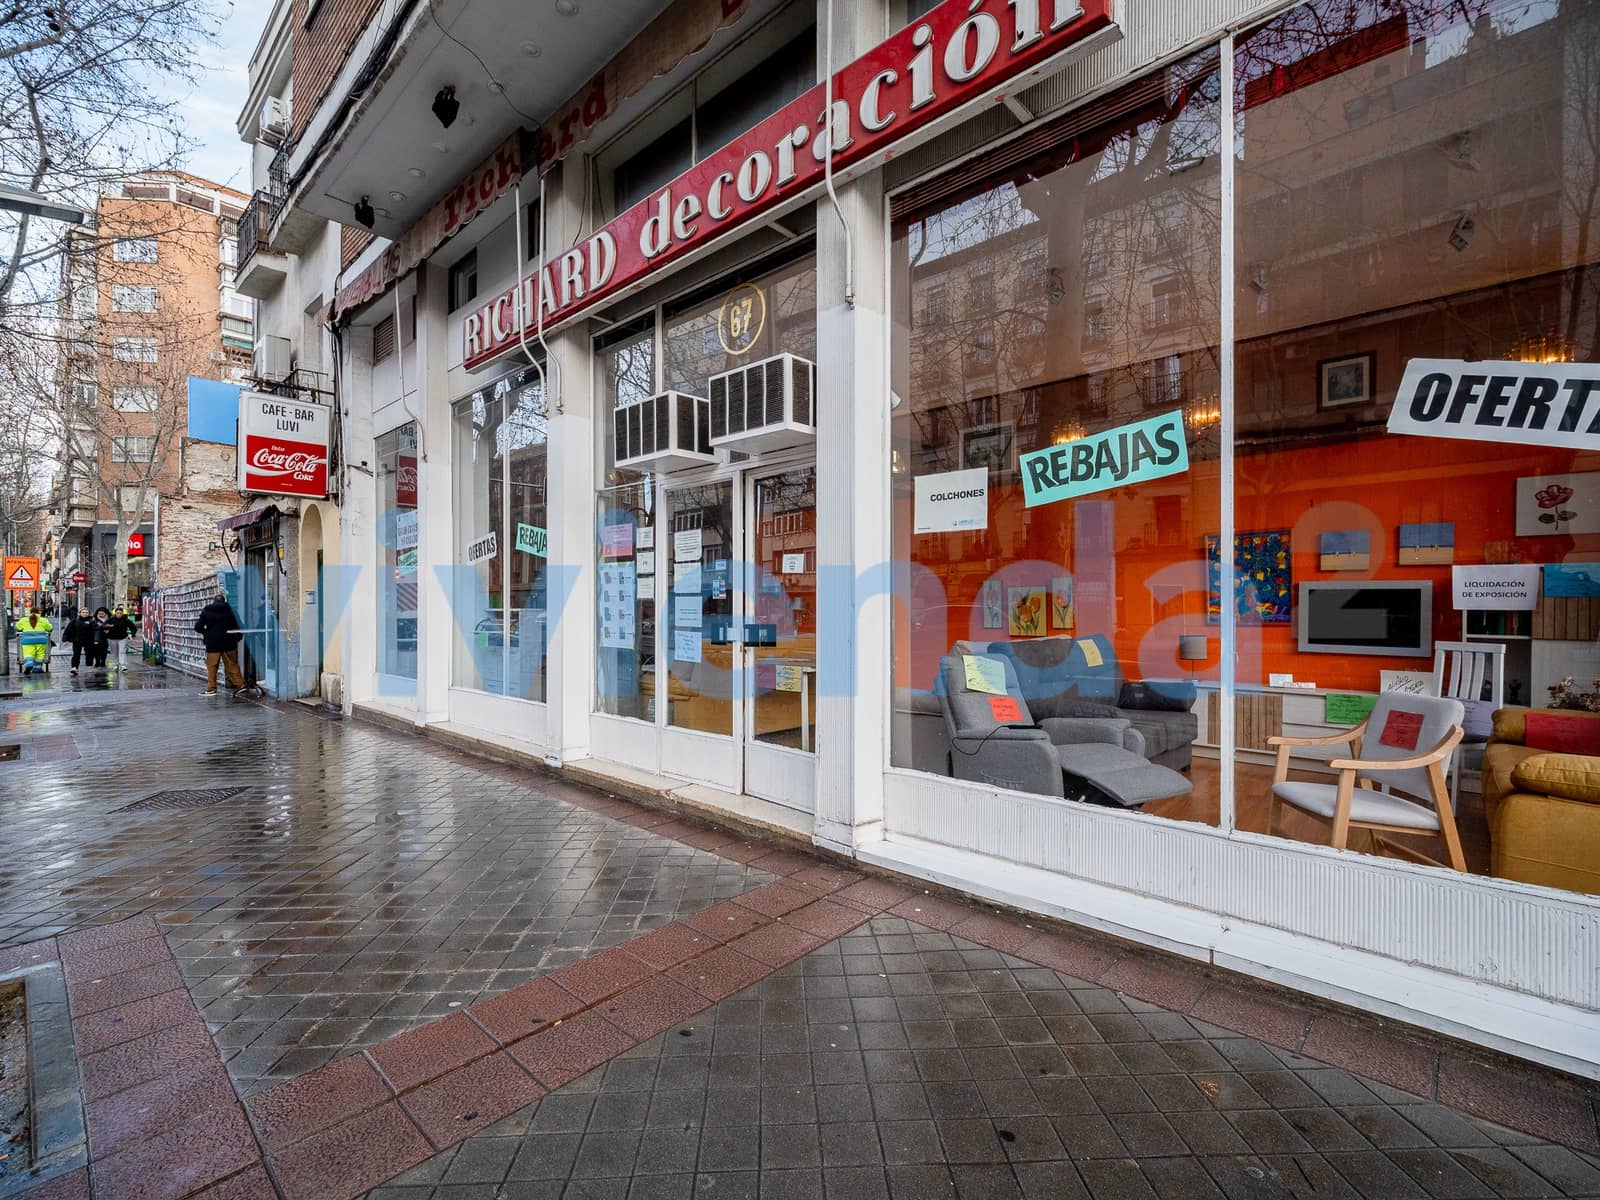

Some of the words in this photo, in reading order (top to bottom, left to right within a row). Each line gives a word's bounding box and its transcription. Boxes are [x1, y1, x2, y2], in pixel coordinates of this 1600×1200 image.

[464, 230, 616, 361] RICHARD
[639, 0, 1085, 259] decoración
[730, 298, 753, 338] 67
[262, 403, 286, 417] CAFE
[295, 408, 314, 421] BAR
[276, 418, 299, 432] LUVI
[1026, 422, 1180, 494] REBAJAS
[930, 488, 984, 502] COLCHONES
[467, 536, 496, 562] OFERTAS
[1464, 579, 1525, 588] LIQUIDACIÓN
[1475, 590, 1528, 598] EXPOSICIÓN
